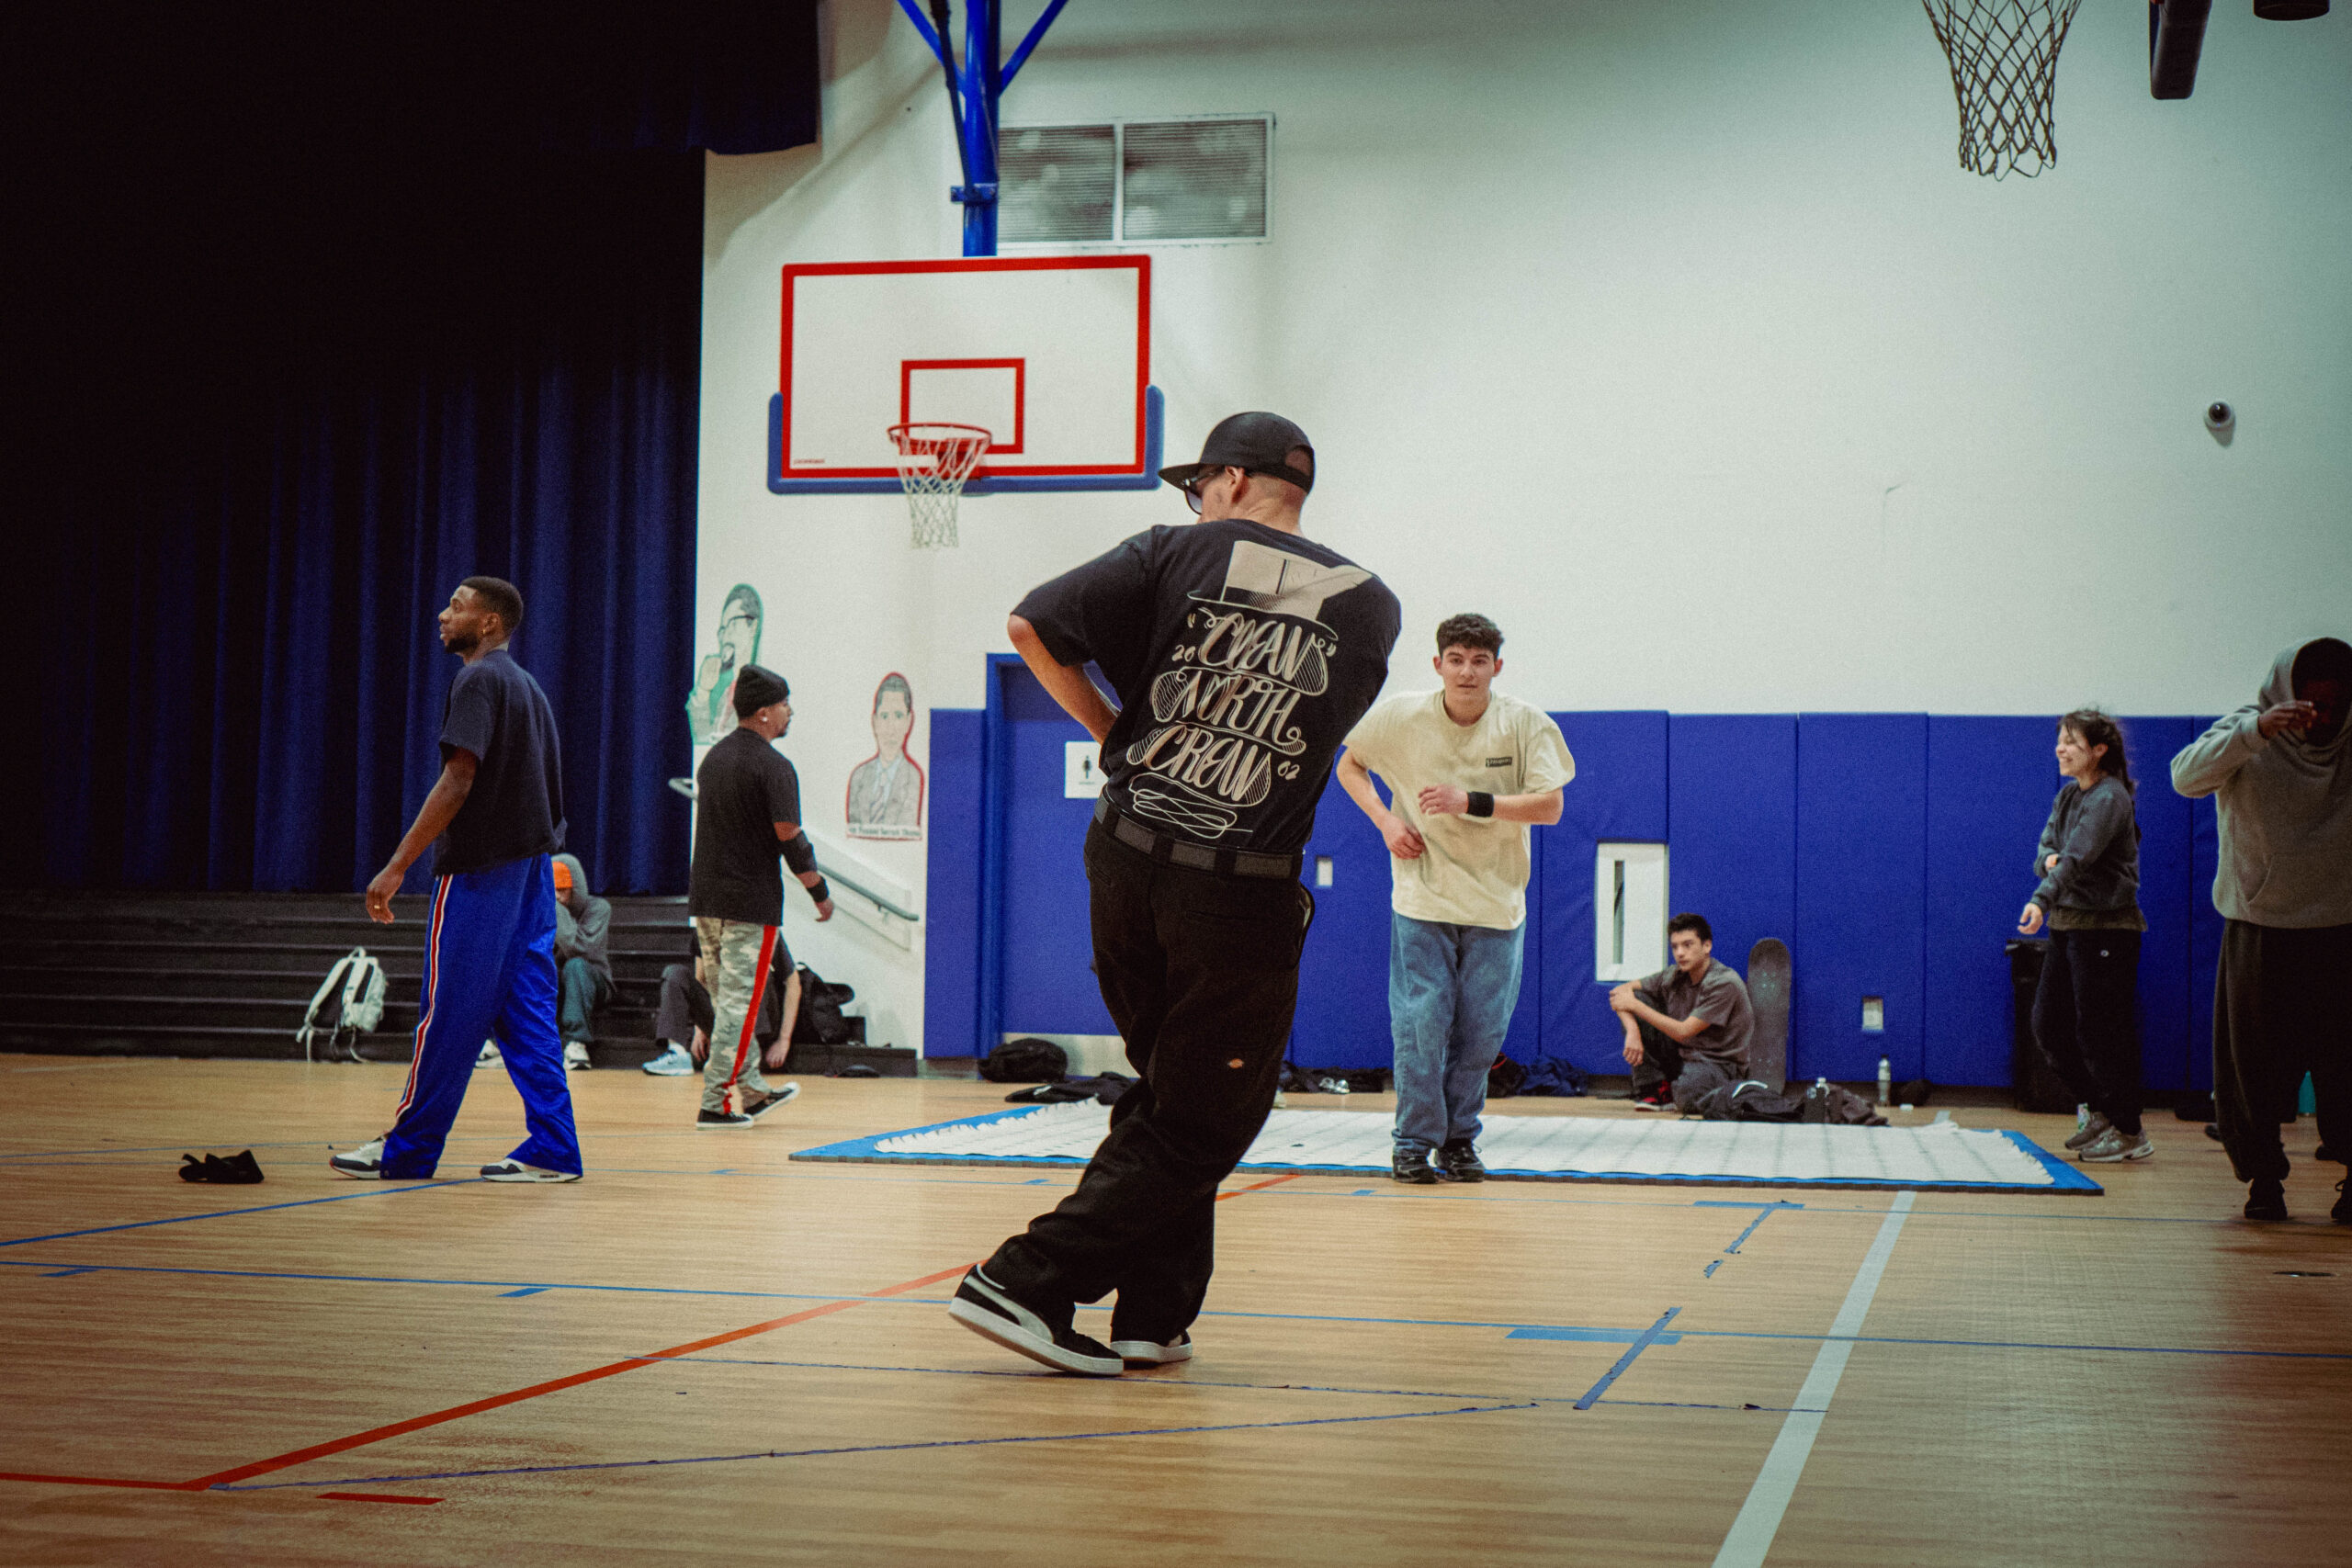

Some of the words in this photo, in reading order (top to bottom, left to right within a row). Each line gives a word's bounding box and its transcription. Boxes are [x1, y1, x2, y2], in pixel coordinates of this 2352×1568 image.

[1171, 644, 1196, 662] 20
[1143, 724, 1272, 802] CREW
[1277, 761, 1301, 780] 02
